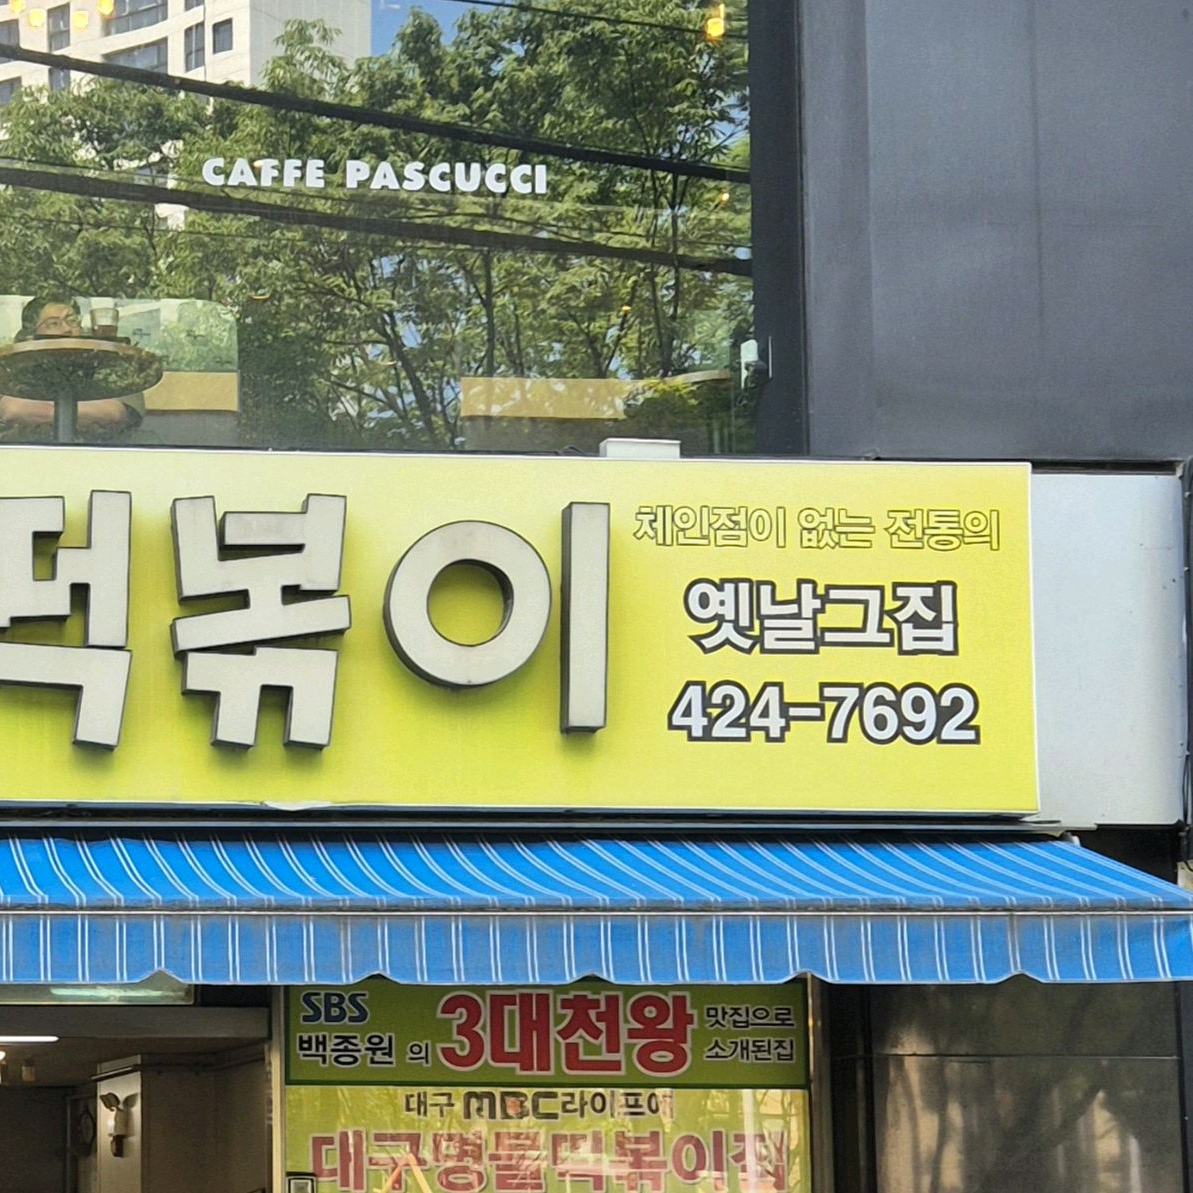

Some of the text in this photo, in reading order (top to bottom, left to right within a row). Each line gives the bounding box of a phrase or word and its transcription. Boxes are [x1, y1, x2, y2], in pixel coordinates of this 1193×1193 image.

[201, 156, 549, 195] CAFFE PASCUCCI
[633, 504, 1001, 552] 체인점이 없는 전통의
[682, 578, 959, 655] 옛날그집
[668, 680, 981, 744] 424-7692
[301, 991, 369, 1024] SBS
[705, 1004, 795, 1030] 맛집으로
[438, 990, 694, 1075] 3대천왕
[404, 1091, 455, 1118] 대구
